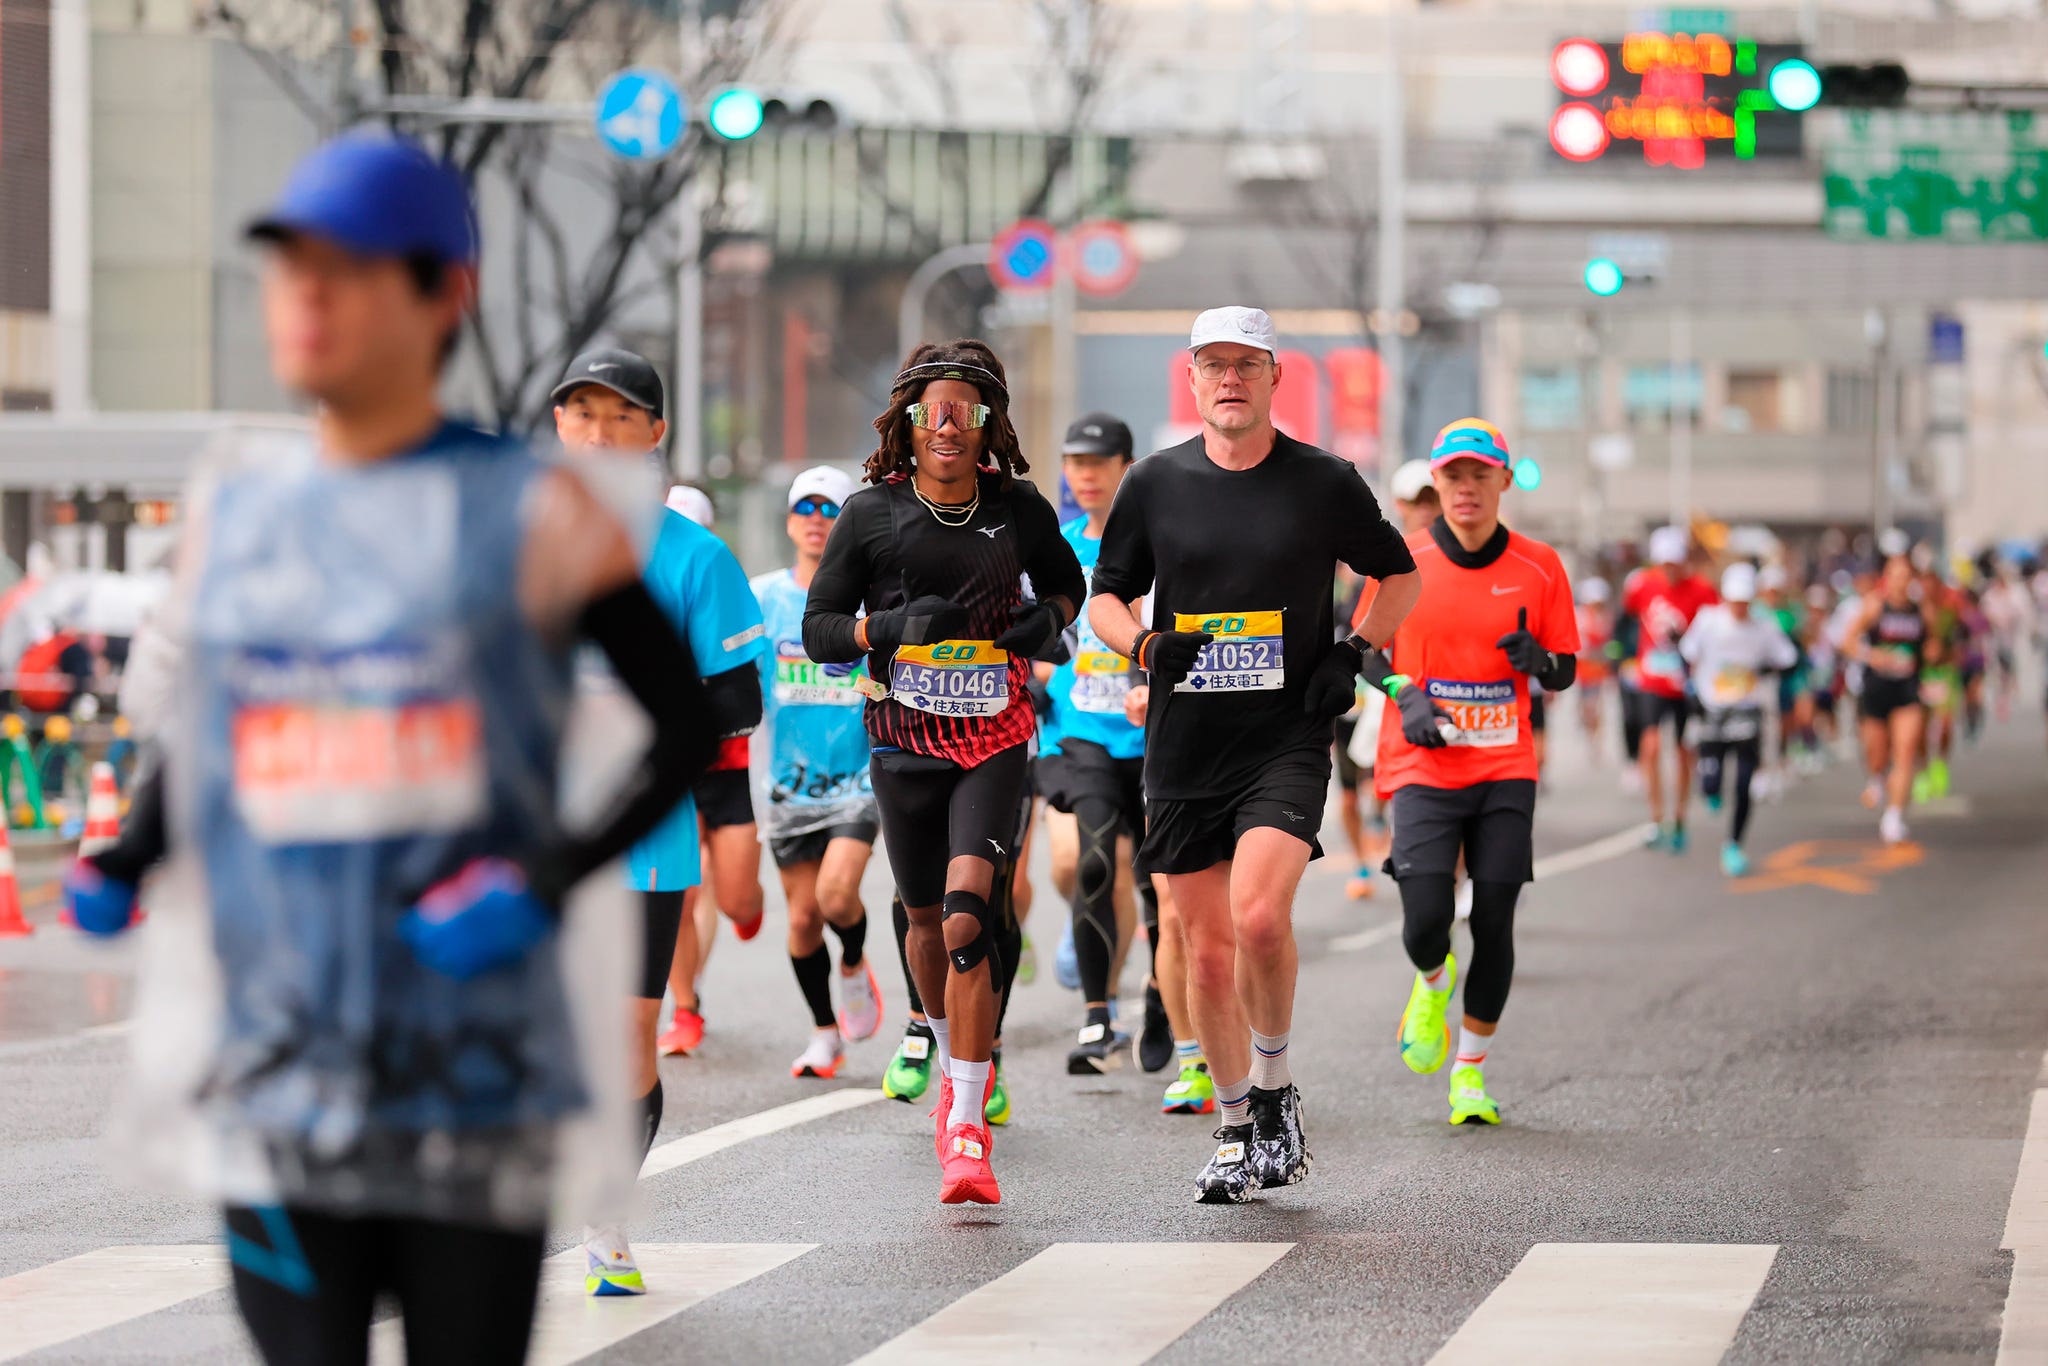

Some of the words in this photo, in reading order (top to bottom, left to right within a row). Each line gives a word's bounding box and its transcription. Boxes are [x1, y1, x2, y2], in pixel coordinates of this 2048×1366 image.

[1210, 674, 1264, 689] 住友電工
[1429, 682, 1474, 698] Osaka
[1474, 684, 1512, 698] Metro
[933, 699, 989, 715] 住友電工
